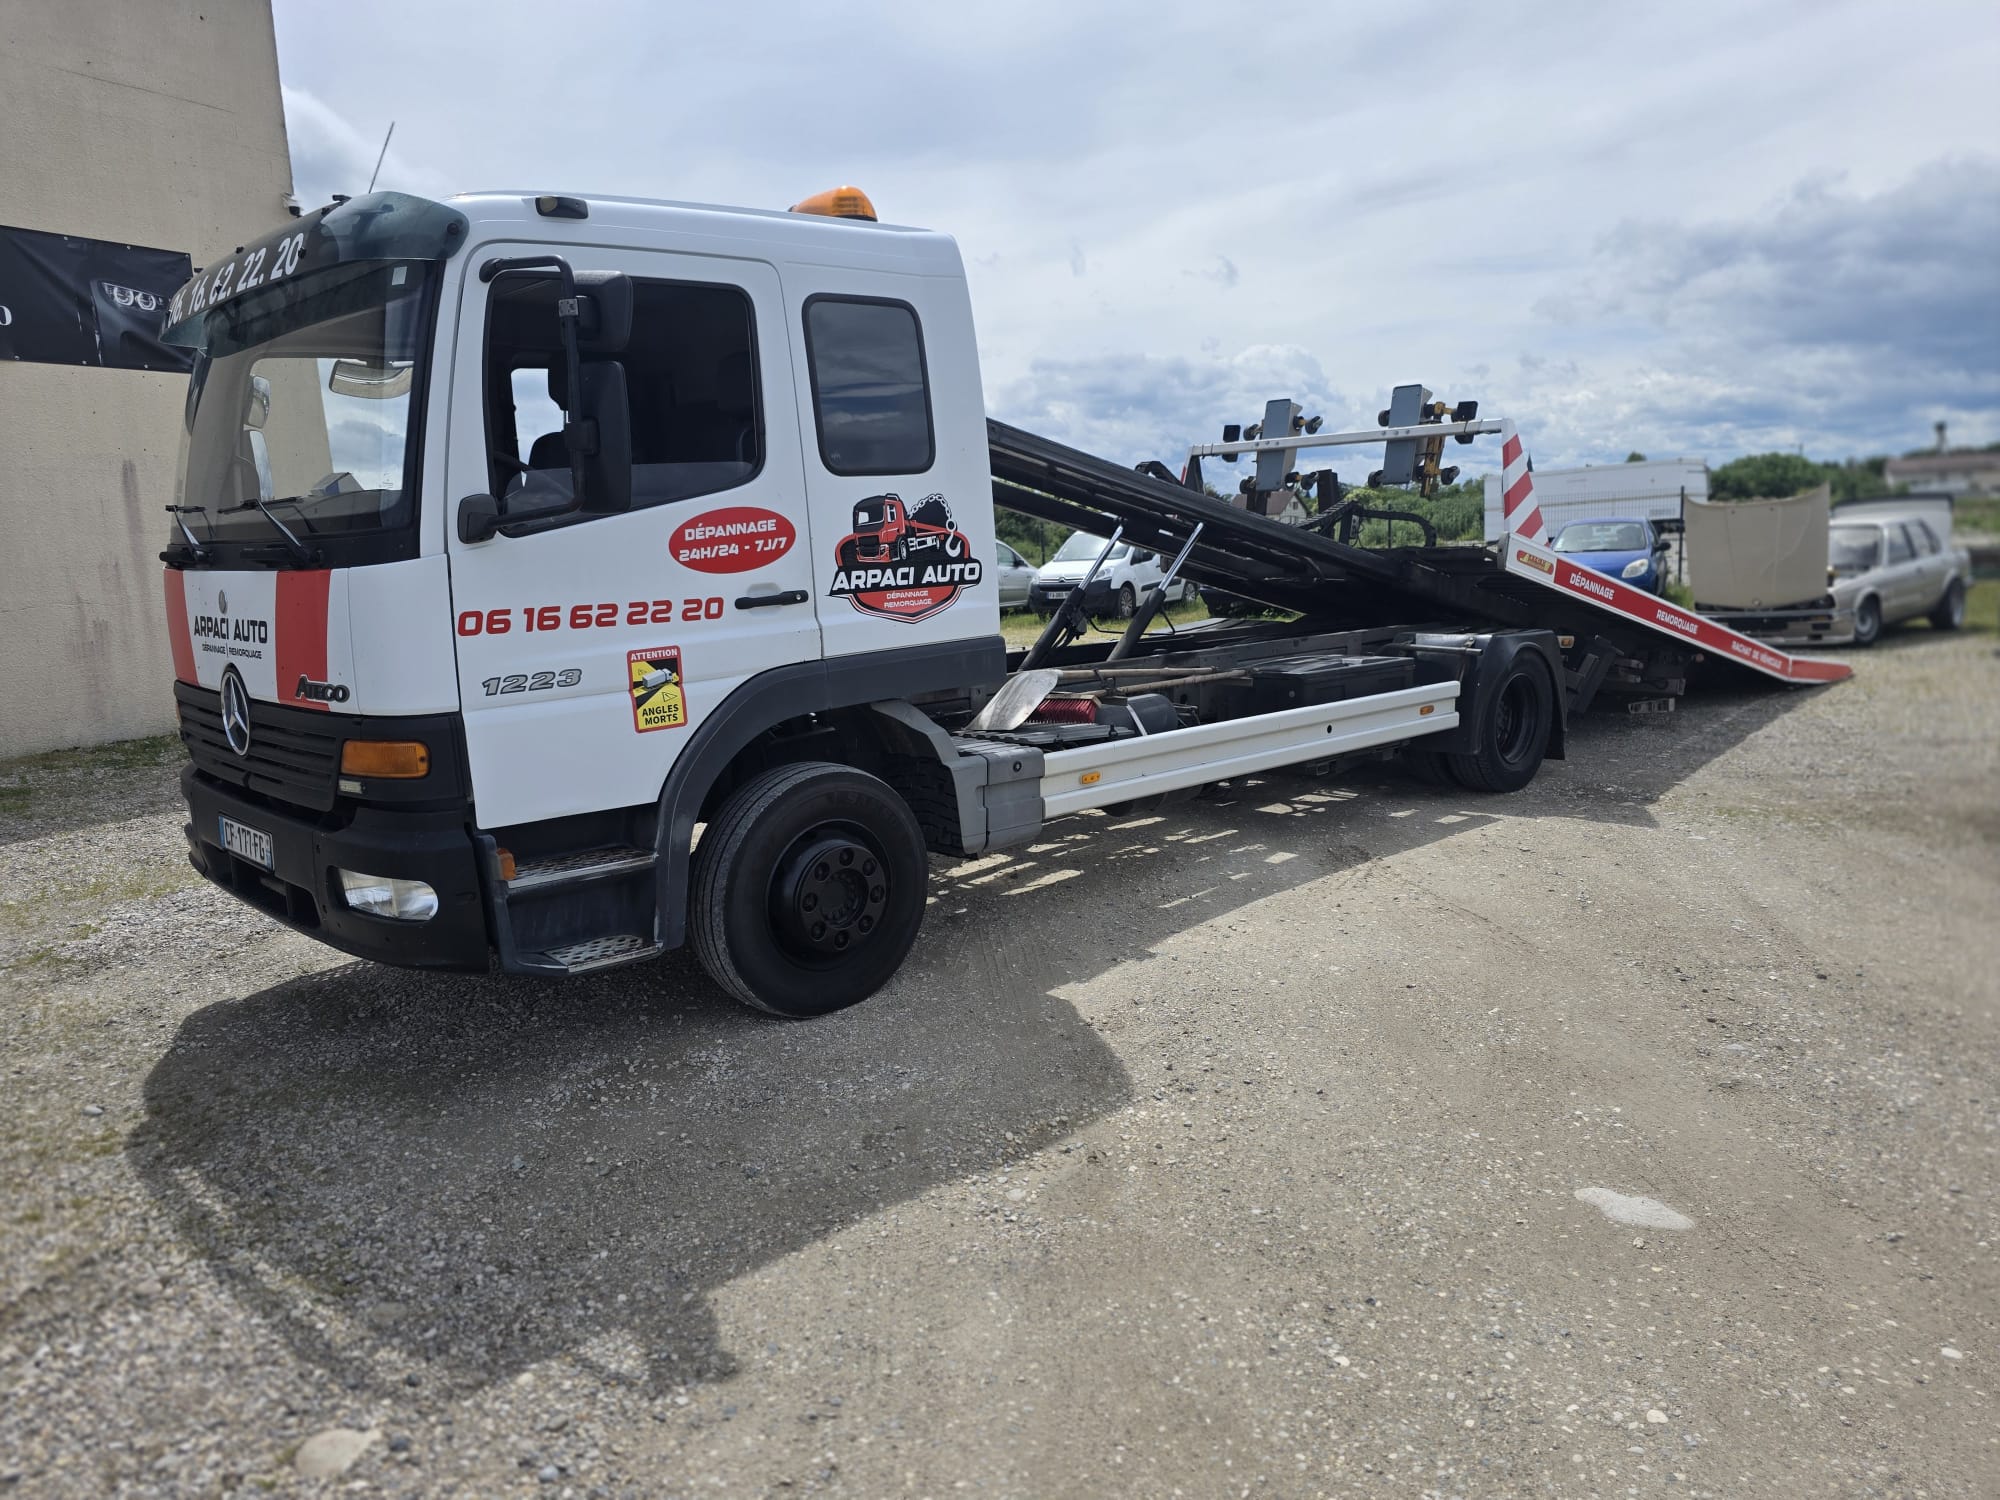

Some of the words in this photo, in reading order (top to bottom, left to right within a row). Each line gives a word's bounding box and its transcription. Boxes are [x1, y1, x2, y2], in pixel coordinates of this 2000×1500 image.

[236, 248, 266, 293] 22.
[270, 232, 304, 280] 20
[684, 519, 777, 541] DÉPANNAGE
[679, 543, 739, 562] 24H/24
[755, 537, 788, 552] 7J/7
[832, 567, 914, 591] ARPACI
[922, 562, 980, 584] AUTO
[1569, 571, 1615, 600] DÉPANNAGE
[884, 598, 932, 609] REMORQUAGE
[886, 590, 929, 600] DÉPANNAGE
[457, 609, 511, 636] 06
[523, 606, 561, 632] 16
[569, 603, 618, 629] 62
[626, 600, 672, 625] 22
[681, 597, 724, 621] 20
[1656, 609, 1698, 634] REMORQUAGE
[194, 615, 229, 640] ARPACI
[234, 618, 268, 644] AUTO
[229, 647, 262, 659] REMORQUAGE
[631, 648, 678, 661] ATTENTION
[481, 668, 582, 696] 1223
[642, 704, 679, 717] ANGLES
[645, 713, 679, 726] MORTS
